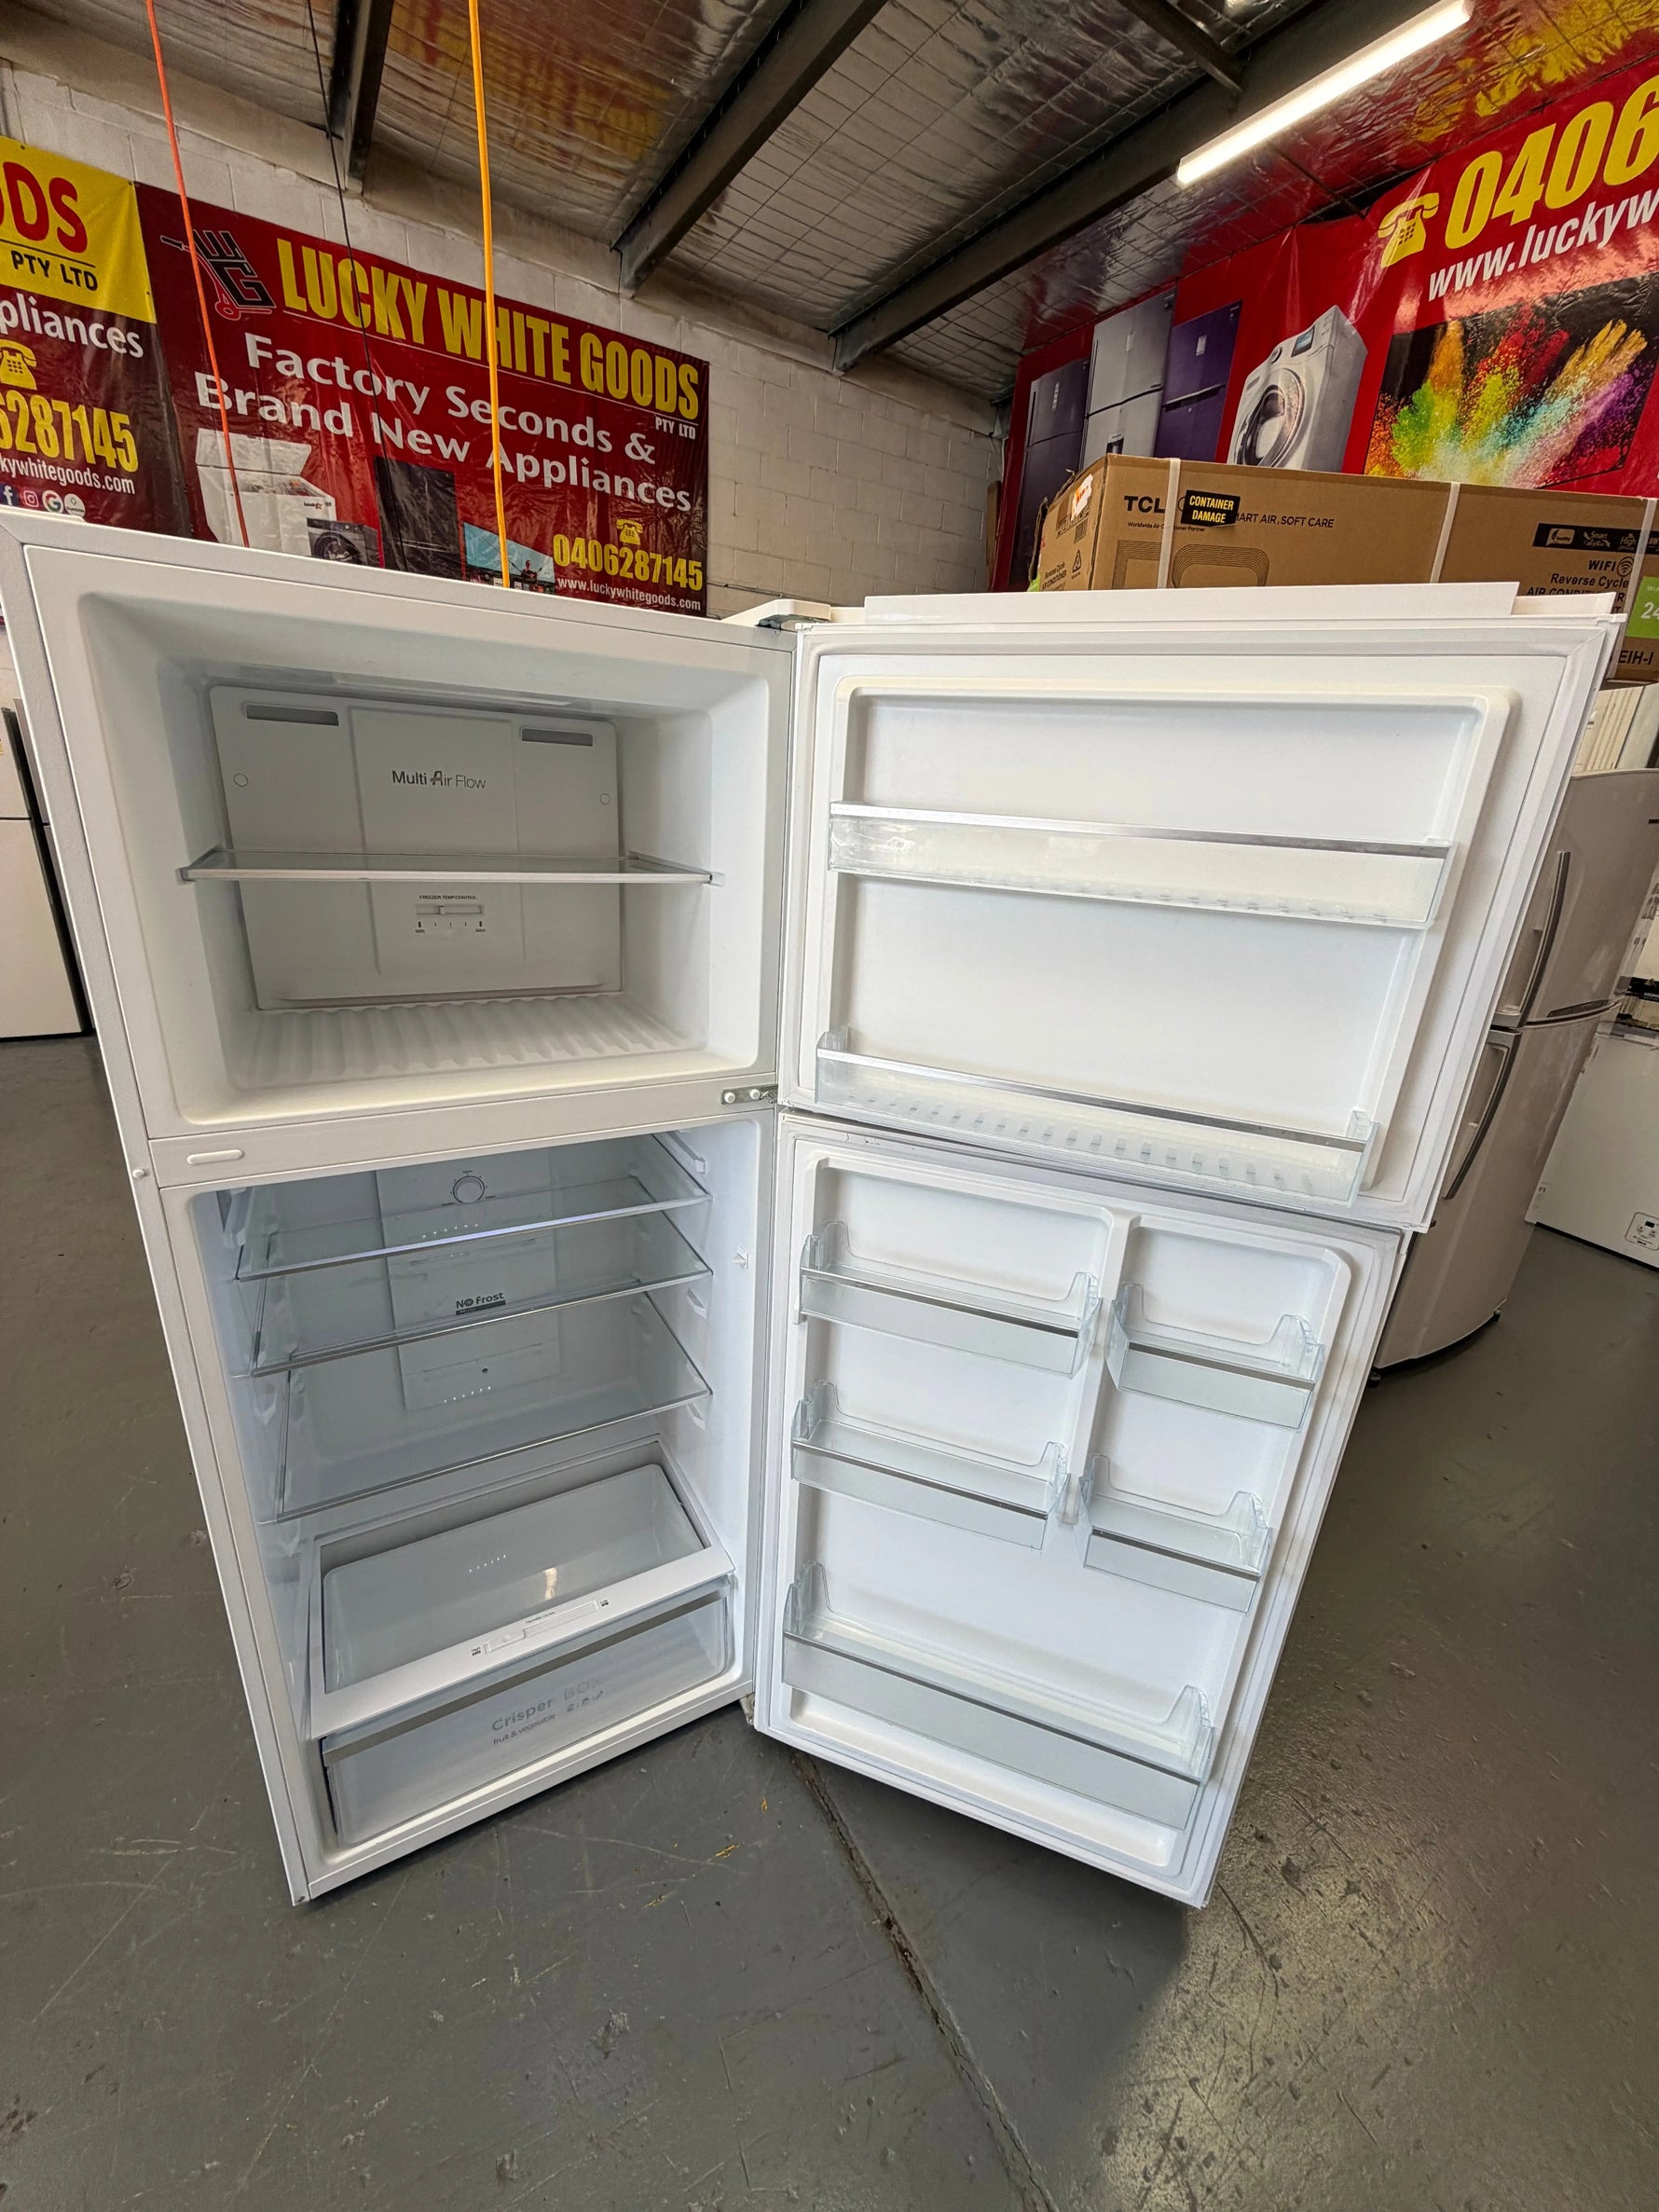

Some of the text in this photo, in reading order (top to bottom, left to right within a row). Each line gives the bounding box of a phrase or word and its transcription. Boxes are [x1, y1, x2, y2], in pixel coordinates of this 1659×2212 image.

[1445, 75, 1659, 249] 0406
[0, 161, 88, 254] DS
[11, 250, 98, 292] PTY LTD
[277, 239, 701, 419] LUCKY WHITE GOODS
[245, 332, 656, 464] Factory Seconds &
[194, 371, 692, 512] Brand New Appliances
[655, 416, 697, 440] PTY LTD
[1124, 495, 1166, 514] TCL
[1189, 495, 1235, 512] CONTAINER
[1192, 509, 1227, 524] DAMAGE
[1236, 512, 1258, 523] ART
[1281, 515, 1307, 527] SOFT
[1308, 517, 1335, 529] CARE
[553, 533, 703, 591] 0406287145
[1588, 559, 1617, 571] WIFI
[557, 577, 701, 611] www.luckywhitegoods.com
[1550, 572, 1629, 589] Reverse Cycle
[391, 770, 487, 789] Multi Air Flow
[475, 1292, 504, 1305] Frost
[492, 1698, 553, 1731] Crisper
